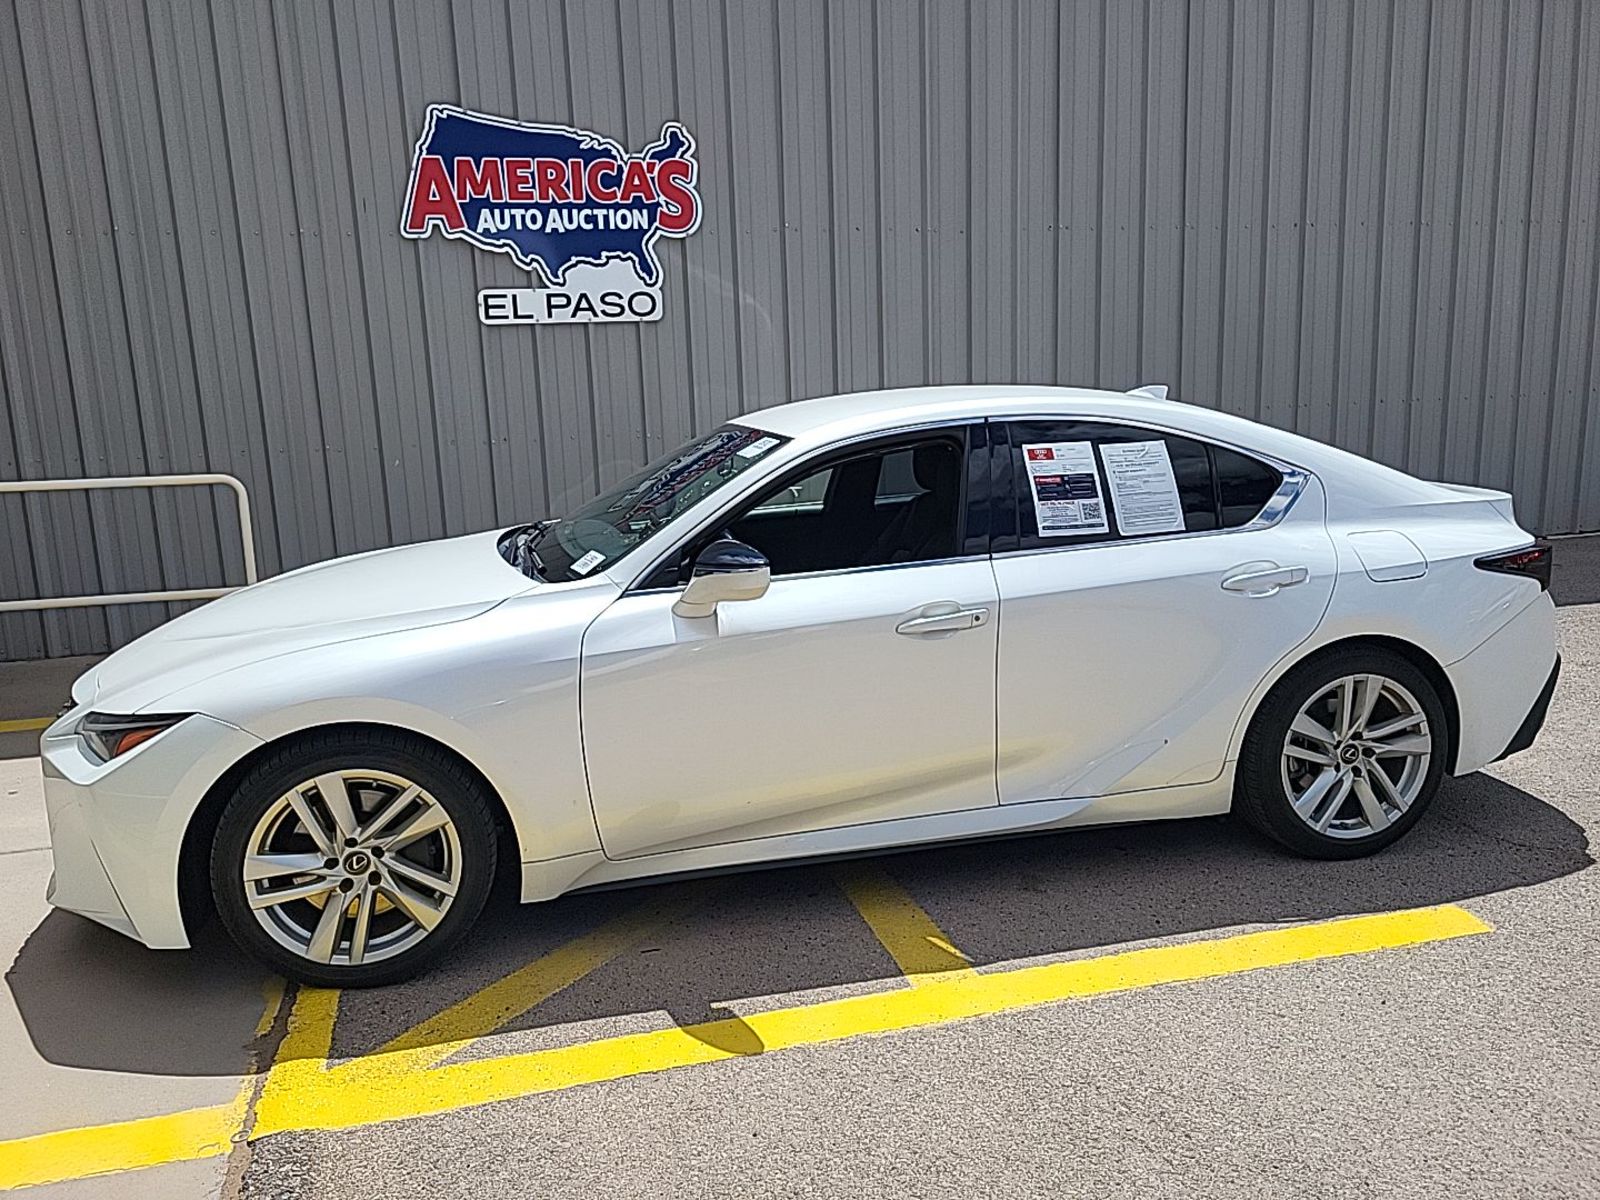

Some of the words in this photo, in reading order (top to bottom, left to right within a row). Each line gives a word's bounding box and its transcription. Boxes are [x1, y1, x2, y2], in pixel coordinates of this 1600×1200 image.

[406, 156, 697, 232] AMERICA'S
[477, 208, 543, 233] AUTO
[545, 208, 648, 233] AUCTION
[483, 294, 534, 320] EL
[545, 291, 657, 318] PASO
